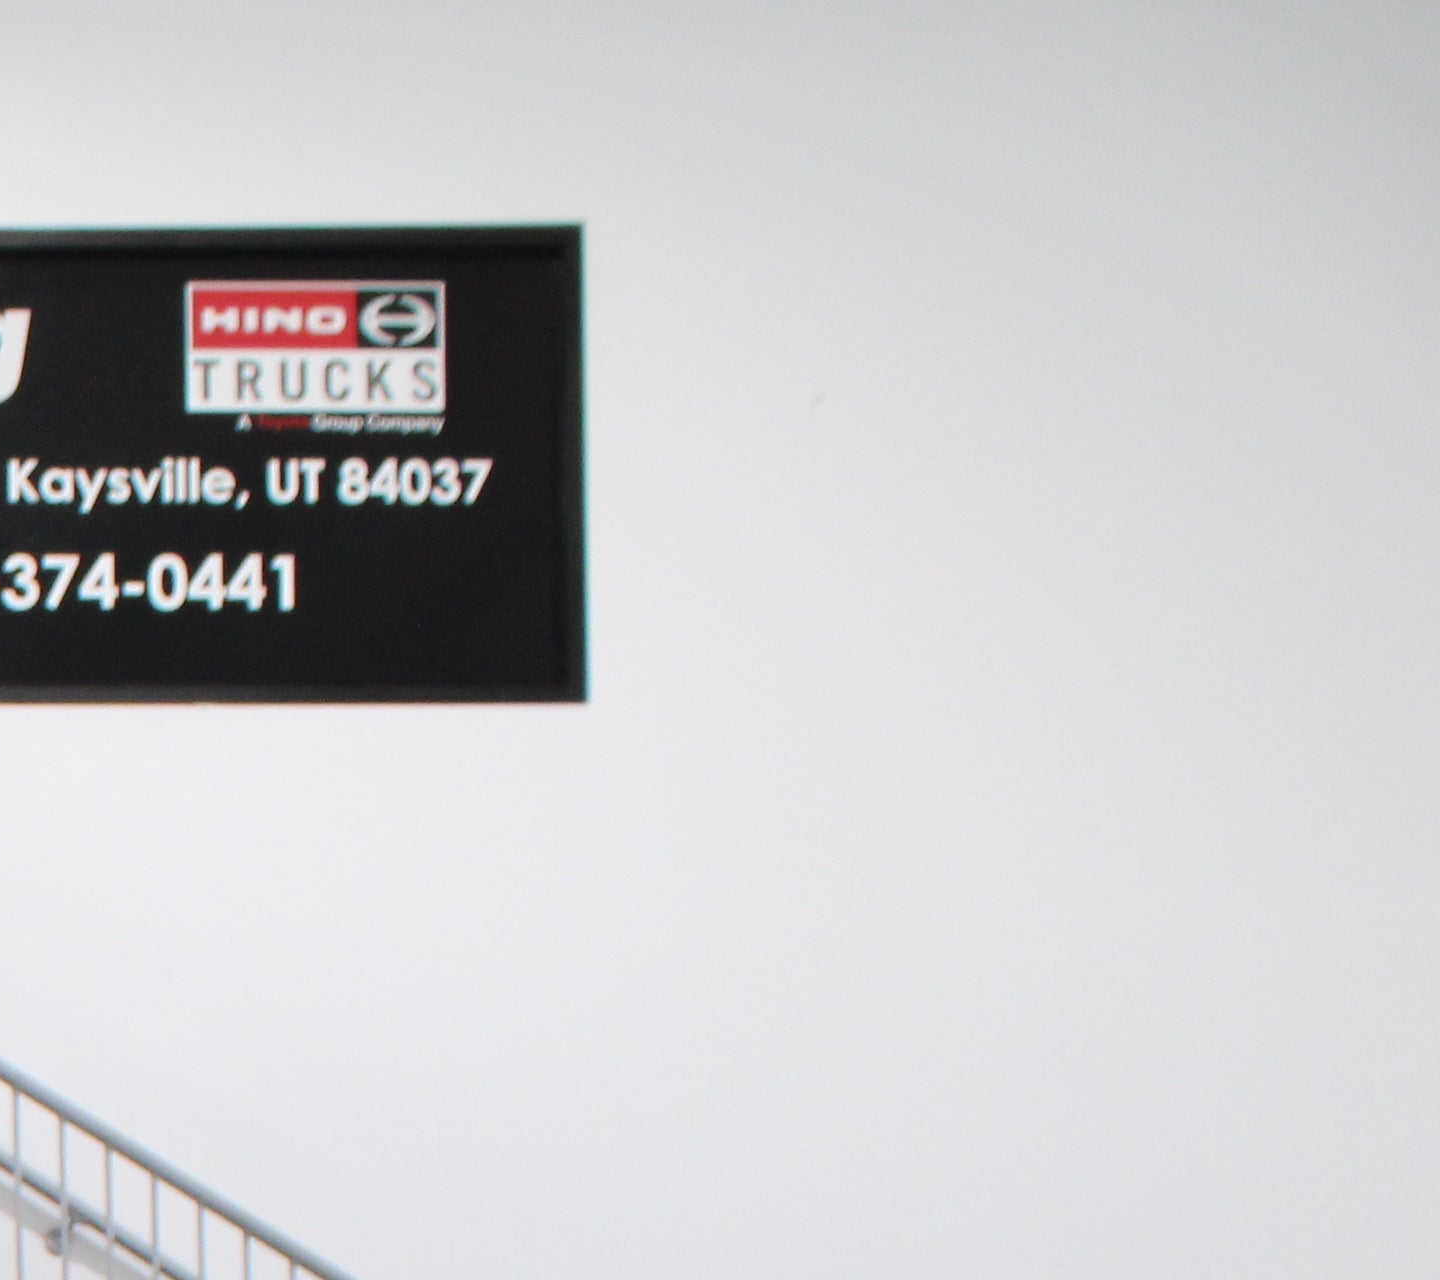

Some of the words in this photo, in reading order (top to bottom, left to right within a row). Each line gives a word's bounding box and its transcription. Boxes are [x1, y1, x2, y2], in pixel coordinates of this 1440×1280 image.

[200, 305, 348, 336] HINO
[194, 356, 439, 401] TRUCKS
[5, 456, 250, 515] Kaysville,
[265, 457, 327, 506] UT
[336, 457, 494, 507] 84037
